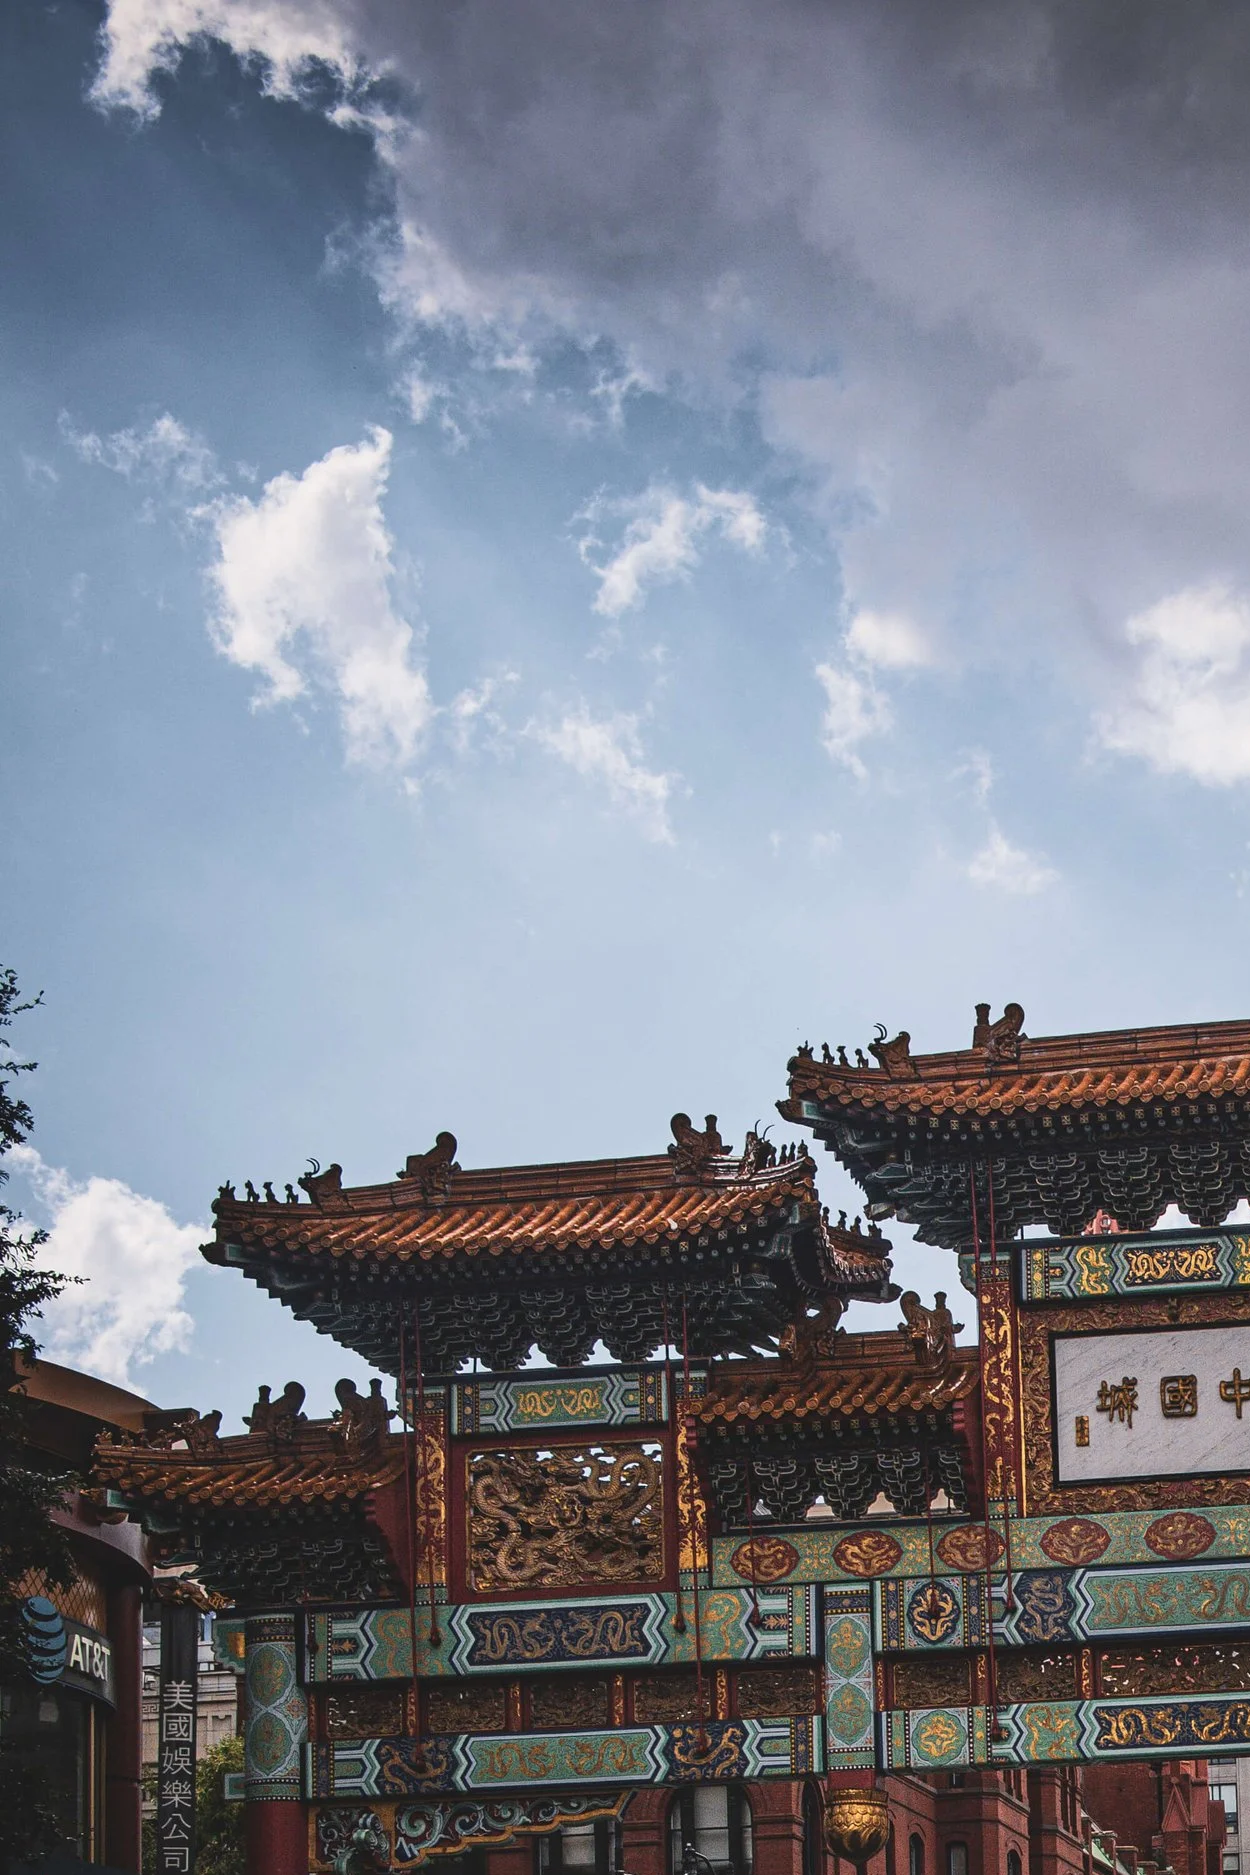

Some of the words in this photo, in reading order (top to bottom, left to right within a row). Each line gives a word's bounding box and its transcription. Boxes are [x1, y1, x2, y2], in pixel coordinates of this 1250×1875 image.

[69, 1633, 112, 1682] AT&T
[161, 1680, 195, 1872] 美國娛樂公司
